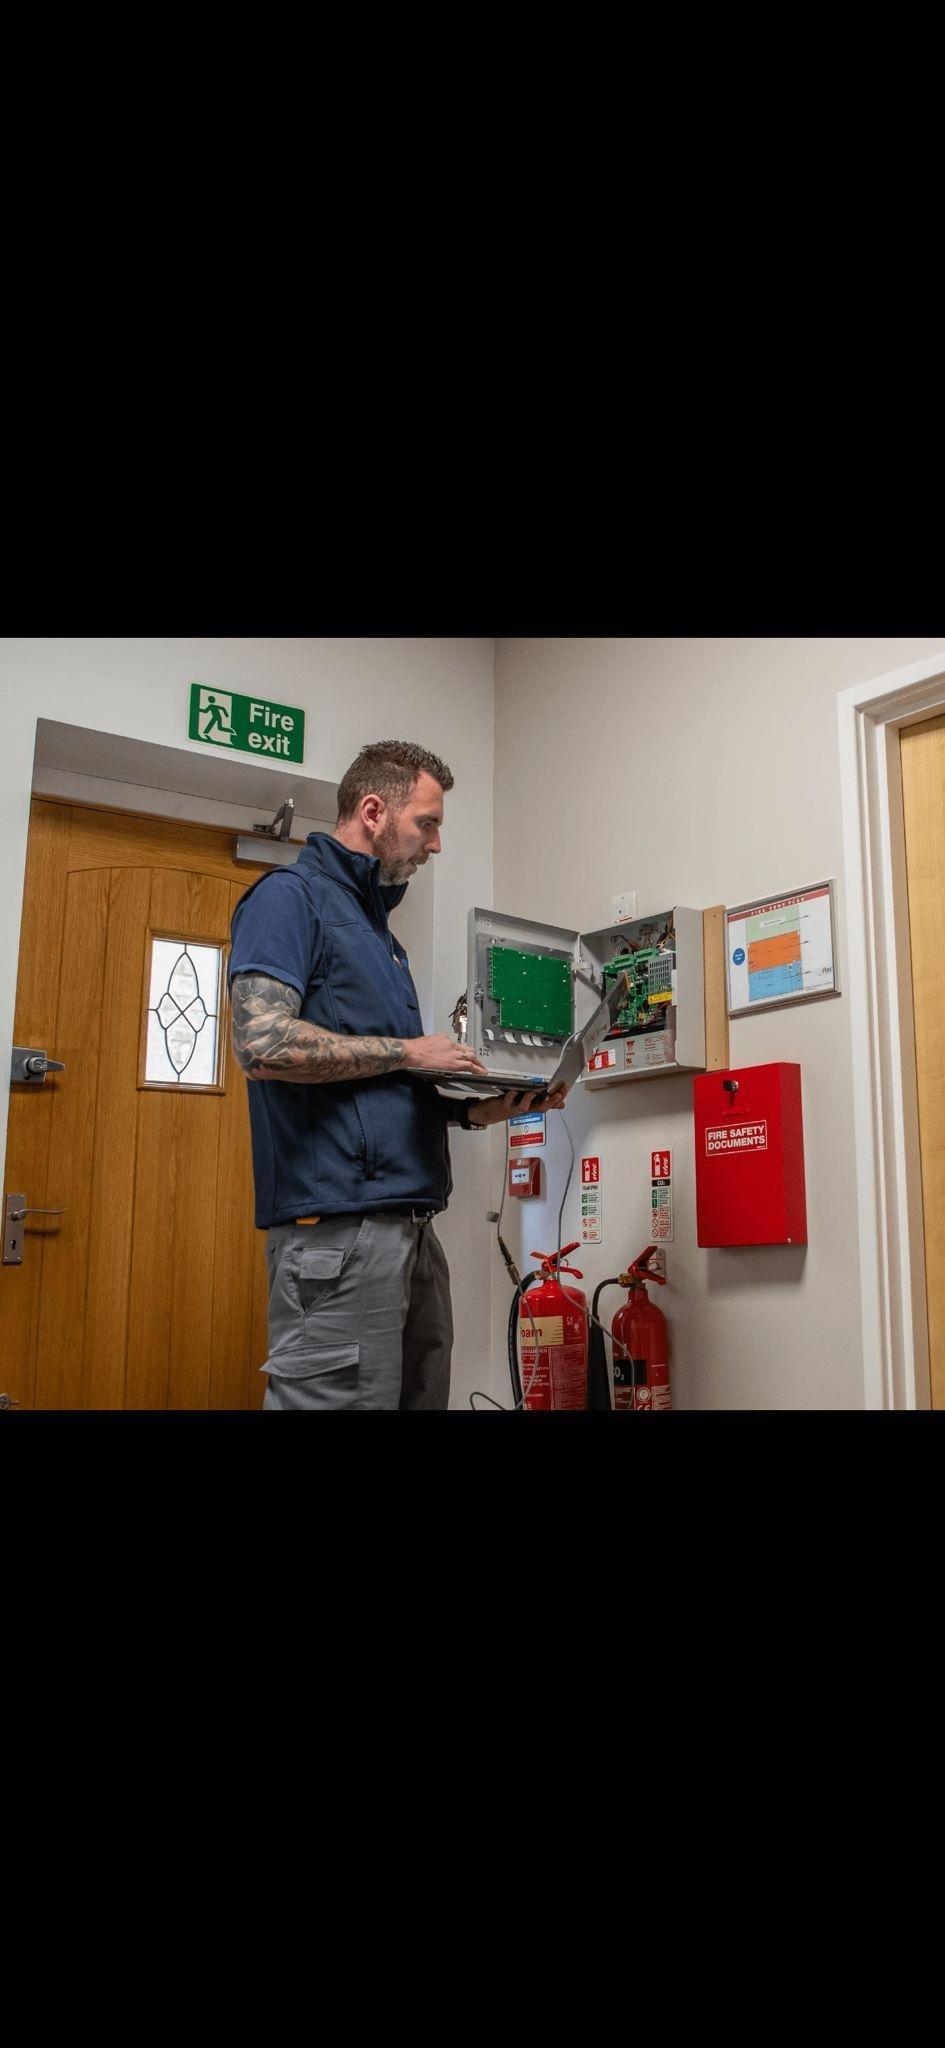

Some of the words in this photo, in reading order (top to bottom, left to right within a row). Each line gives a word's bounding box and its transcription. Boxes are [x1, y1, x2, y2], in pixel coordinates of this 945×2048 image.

[249, 702, 295, 733] Fire
[247, 731, 290, 756] exit
[751, 908, 766, 916] FIRE
[768, 903, 786, 912] ZONE
[788, 897, 806, 906] PLAN
[708, 1130, 728, 1140] FIRE
[730, 1125, 765, 1138] SAFETY
[708, 1135, 765, 1150] DOCUMENTS
[519, 1328, 543, 1338] oam
